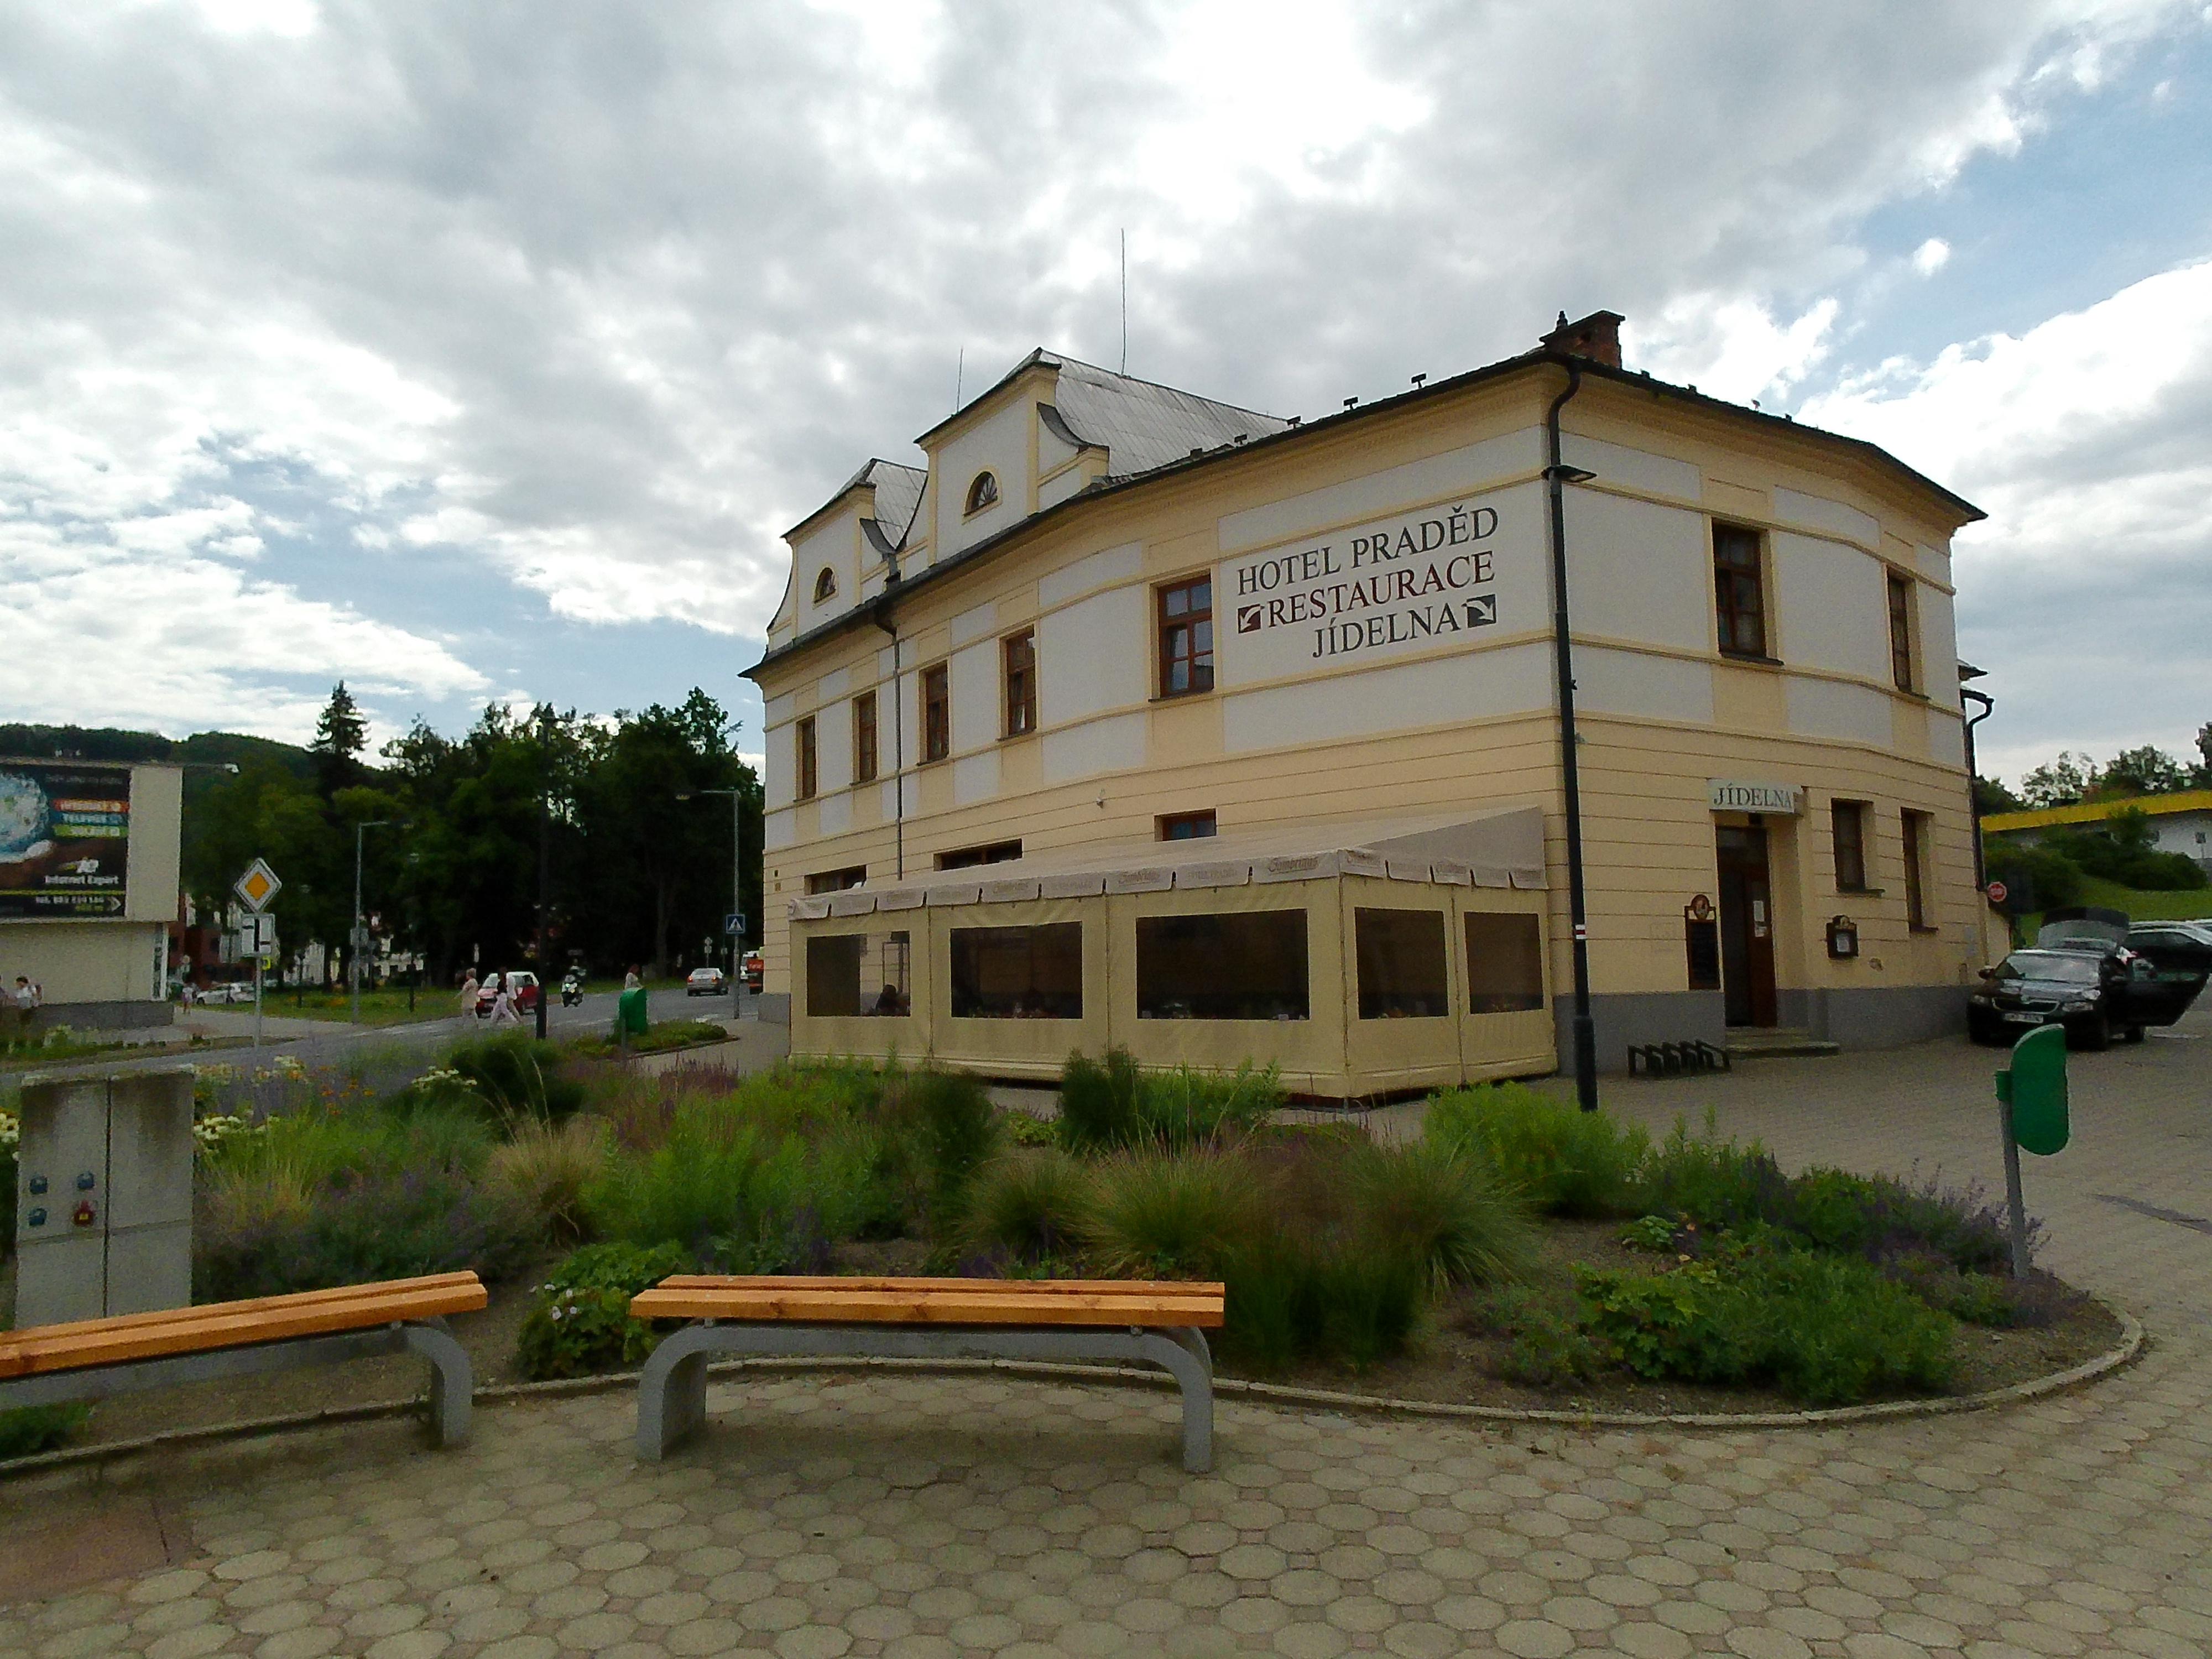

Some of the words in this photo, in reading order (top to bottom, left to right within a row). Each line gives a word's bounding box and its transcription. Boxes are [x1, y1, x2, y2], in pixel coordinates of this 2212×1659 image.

[1238, 546, 1341, 596] HOTEL
[1350, 504, 1499, 568] PRADĚD
[1268, 550, 1495, 628] RESTAURACE
[1312, 602, 1461, 658] JÍDELNA
[1713, 782, 1791, 807] JÍDELNA
